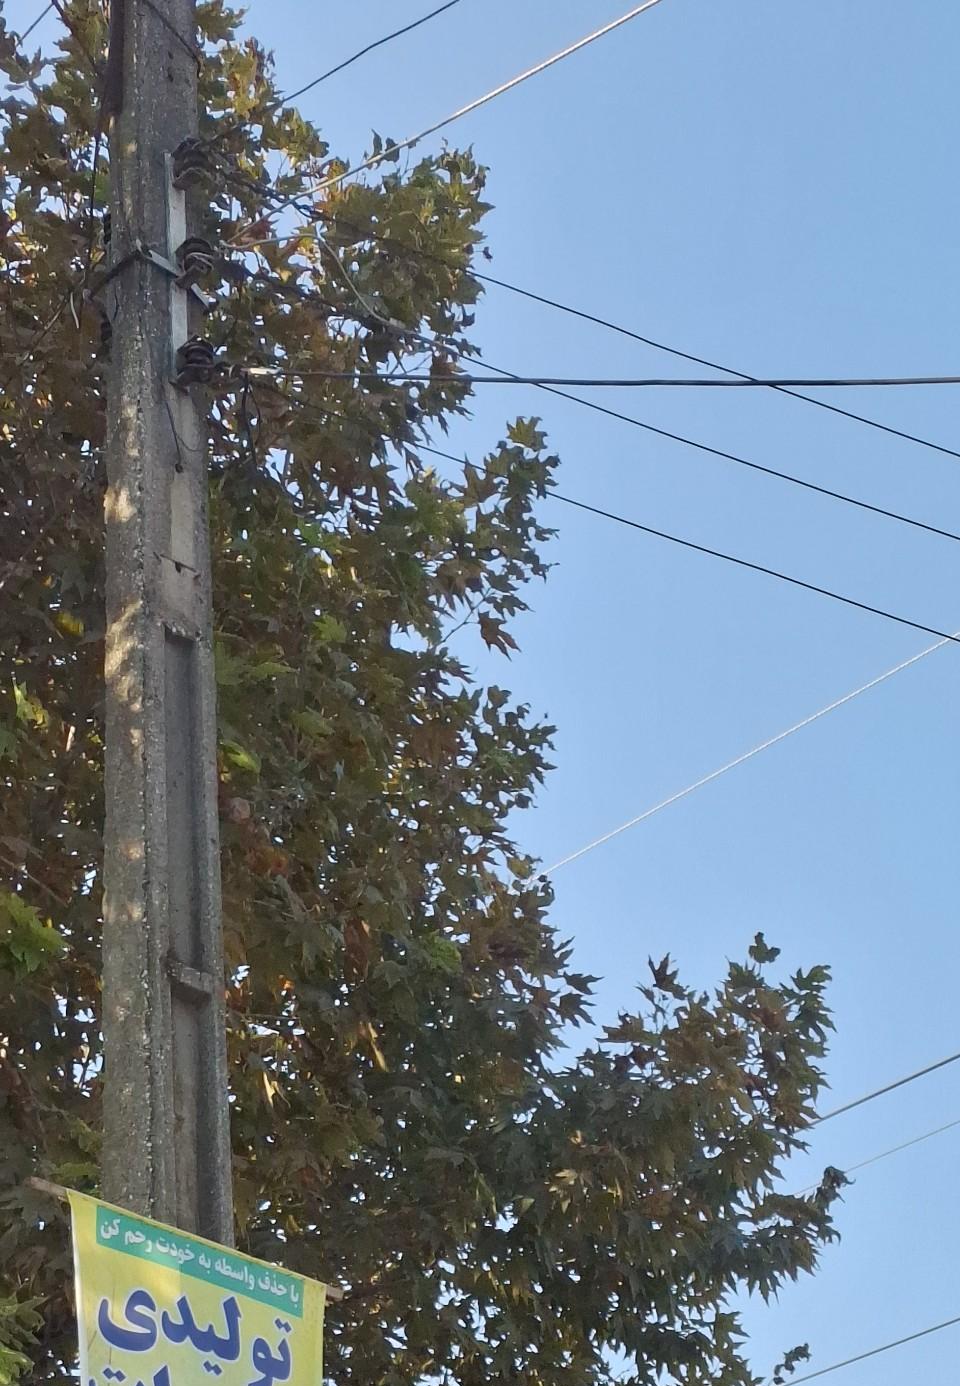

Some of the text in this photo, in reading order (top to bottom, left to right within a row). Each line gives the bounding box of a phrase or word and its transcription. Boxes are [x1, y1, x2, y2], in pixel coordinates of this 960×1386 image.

[100, 1218, 300, 1308] با حذف واسطه به خودت رحم کن
